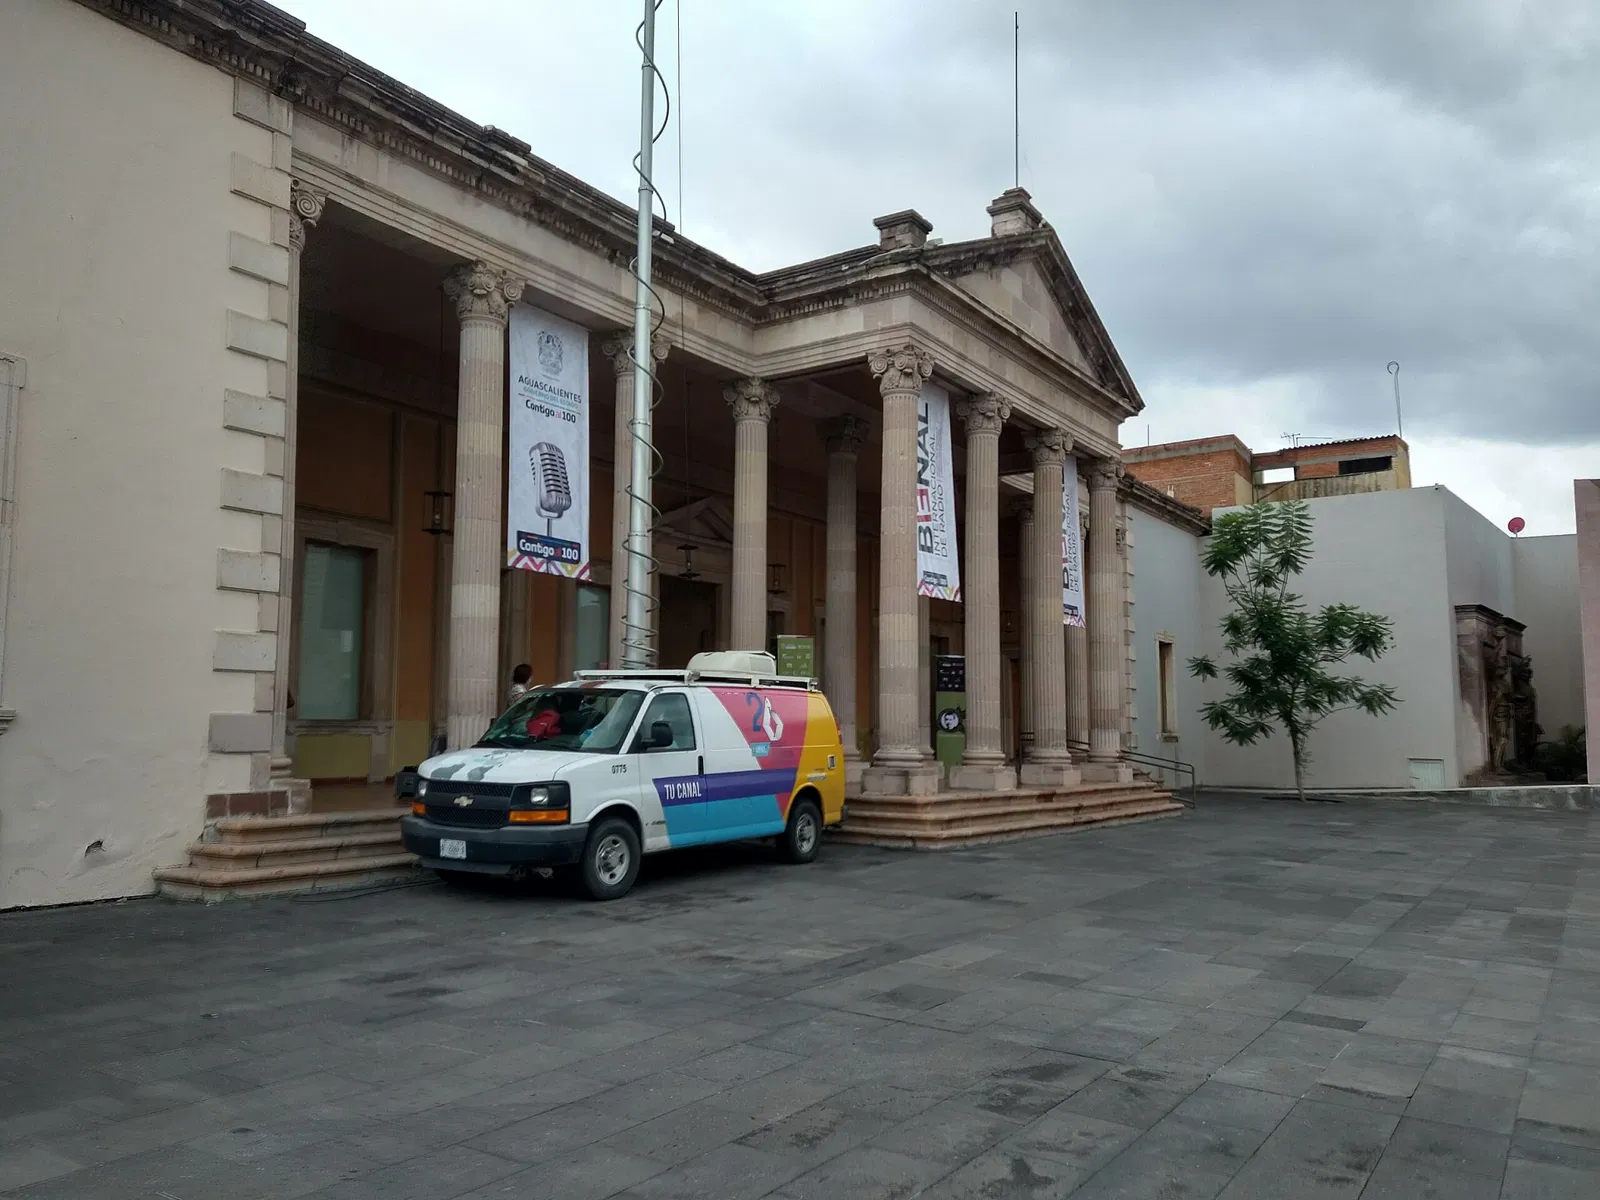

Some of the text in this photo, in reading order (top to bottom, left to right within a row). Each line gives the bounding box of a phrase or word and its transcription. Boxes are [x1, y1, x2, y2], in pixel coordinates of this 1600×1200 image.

[518, 375, 582, 403] AGUASCALIENTES
[525, 399, 555, 417] Contigo
[562, 411, 577, 423] 100
[930, 435, 941, 557] INTERNACIONAL
[936, 484, 949, 558] DE RADIO
[519, 539, 555, 557] Contigo
[561, 547, 579, 560] 100
[611, 764, 627, 774] 0775
[664, 781, 702, 800] TU CANAL
